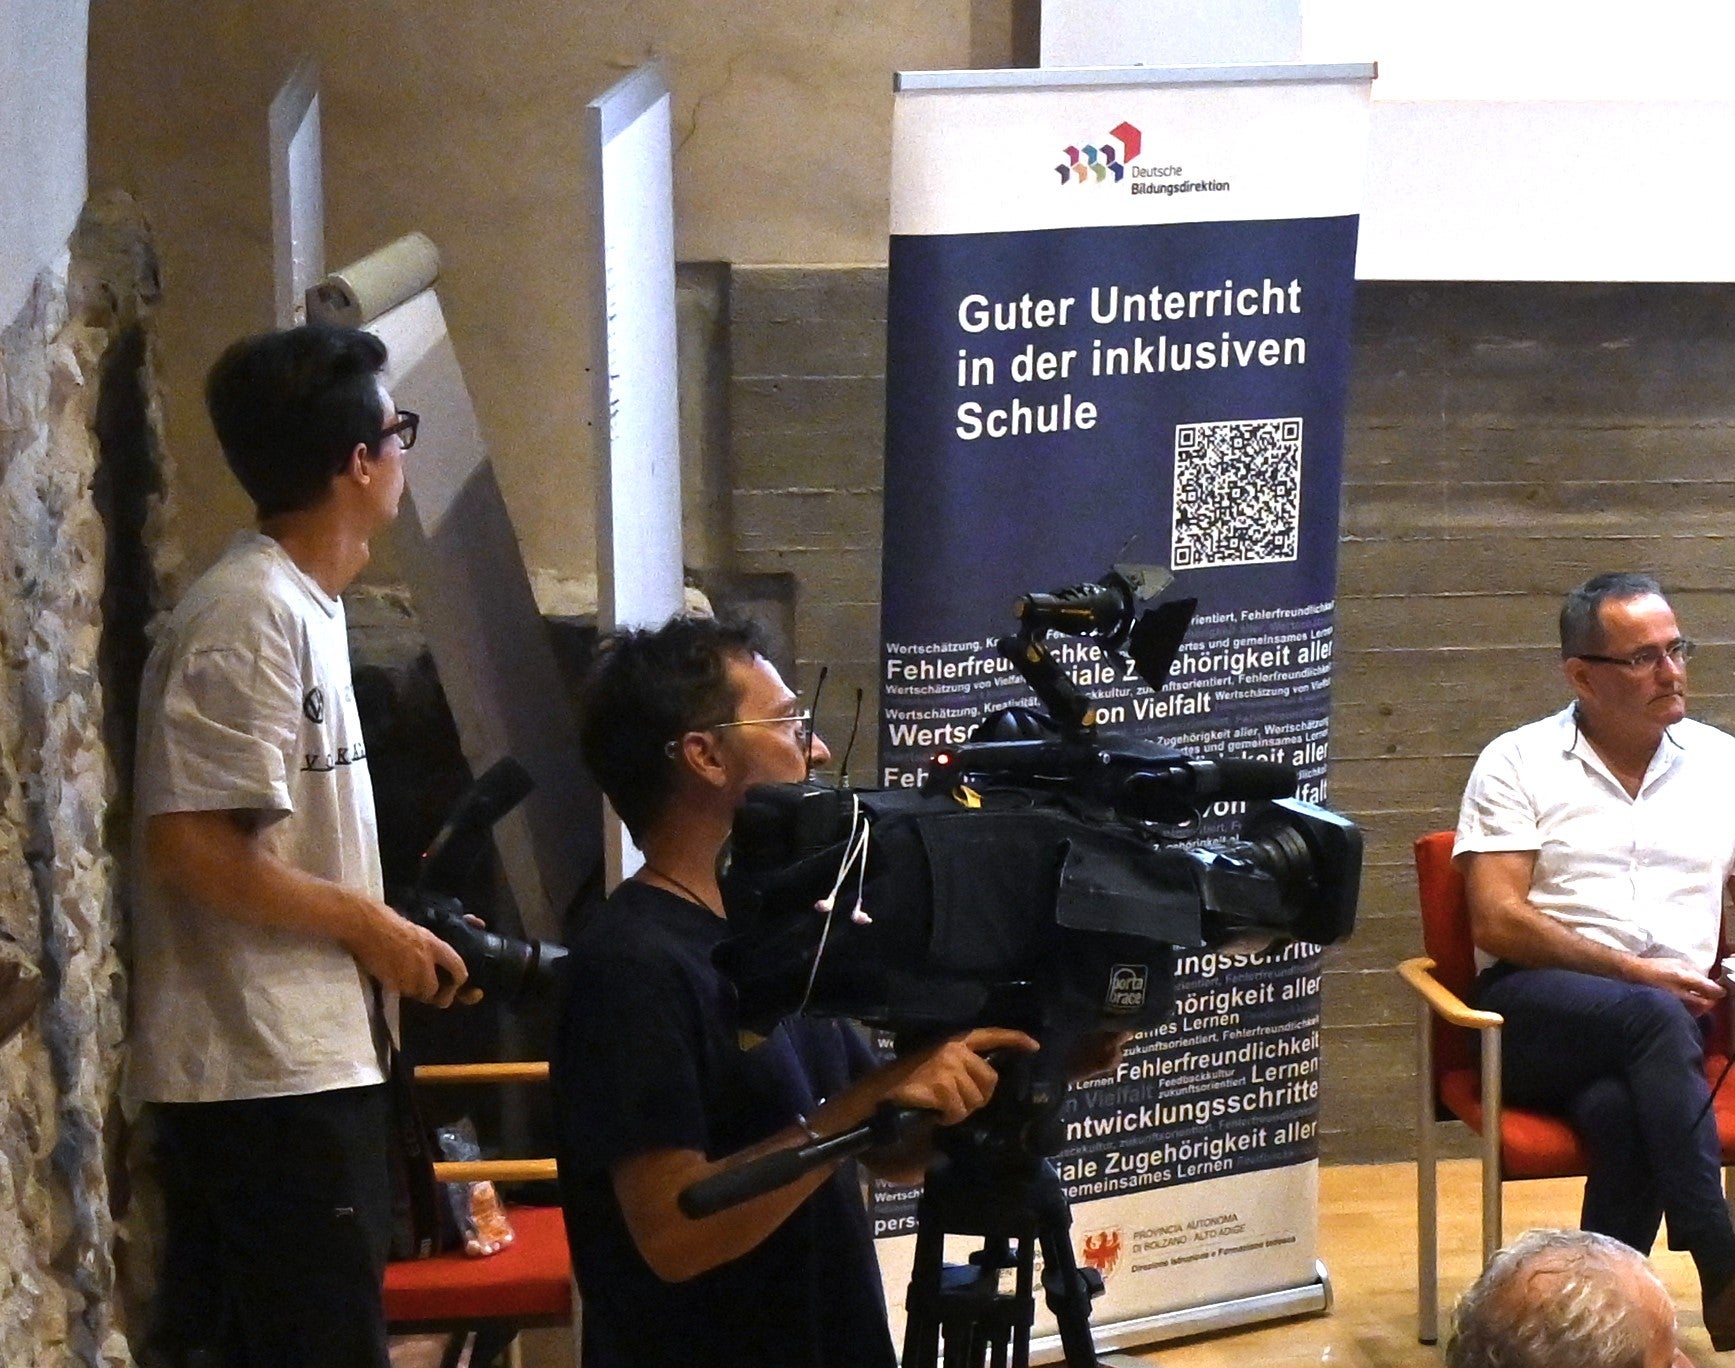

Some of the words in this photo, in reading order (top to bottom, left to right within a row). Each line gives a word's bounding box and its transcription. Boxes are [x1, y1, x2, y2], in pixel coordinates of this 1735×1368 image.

[1131, 165, 1183, 179] Deutsche
[1131, 179, 1231, 196] Bildungsdirektion
[957, 294, 1076, 333] Guter
[1090, 278, 1303, 325] Unterricht
[956, 349, 995, 387] in
[1010, 343, 1077, 381] der
[1092, 331, 1307, 377] inklusiven
[955, 394, 1098, 441] Schule
[1208, 638, 1230, 649] und
[1233, 632, 1308, 648] gemeinsames
[1297, 640, 1334, 659] aller
[1133, 691, 1212, 721] Vielfalt
[1203, 742, 1225, 754] und
[1291, 743, 1329, 767] aller
[1282, 975, 1322, 1001] aller
[1182, 1012, 1241, 1032] Lernen
[1116, 1030, 1320, 1083] Fehlerfreundlichkeit
[1158, 1068, 1236, 1088] Feedbackkultur
[1251, 1057, 1320, 1084] Lernen
[1076, 1076, 1114, 1091] Lernen
[1158, 1076, 1247, 1099] zukunftsorientiert
[1066, 1079, 1319, 1141] ntwicklungsschritte
[1104, 1128, 1267, 1176] Zugehörigkeit
[1274, 1119, 1318, 1146] aller
[1177, 1157, 1233, 1179] Lernen
